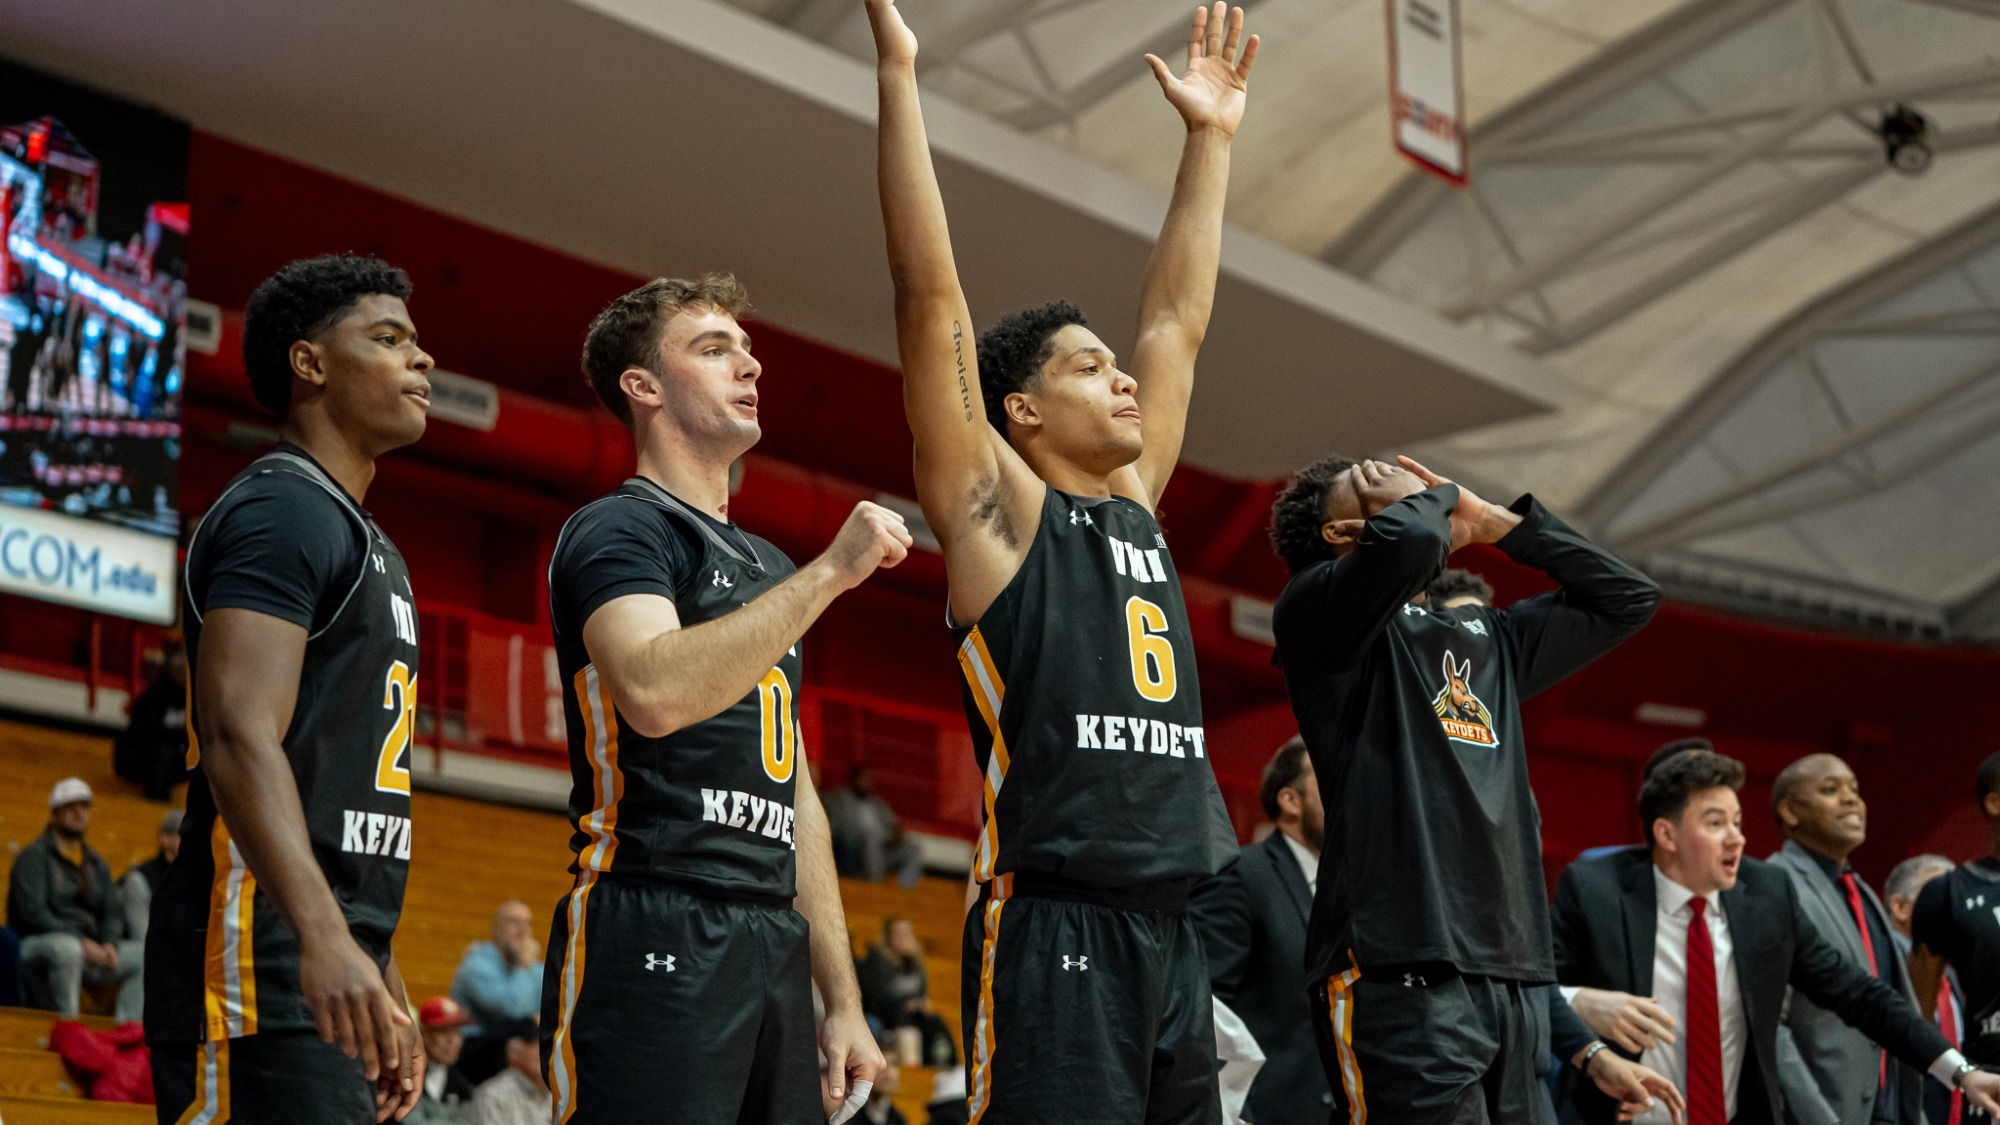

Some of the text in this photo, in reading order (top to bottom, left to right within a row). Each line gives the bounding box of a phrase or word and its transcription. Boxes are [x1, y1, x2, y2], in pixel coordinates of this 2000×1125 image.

[953, 320, 973, 422] Invictus
[0, 522, 157, 597] COM.edu
[1109, 535, 1168, 584] VMI
[1125, 595, 1177, 703] 6
[757, 665, 795, 784] 0
[1441, 720, 1488, 742] KEYDETS
[701, 788, 797, 851] KEYDE
